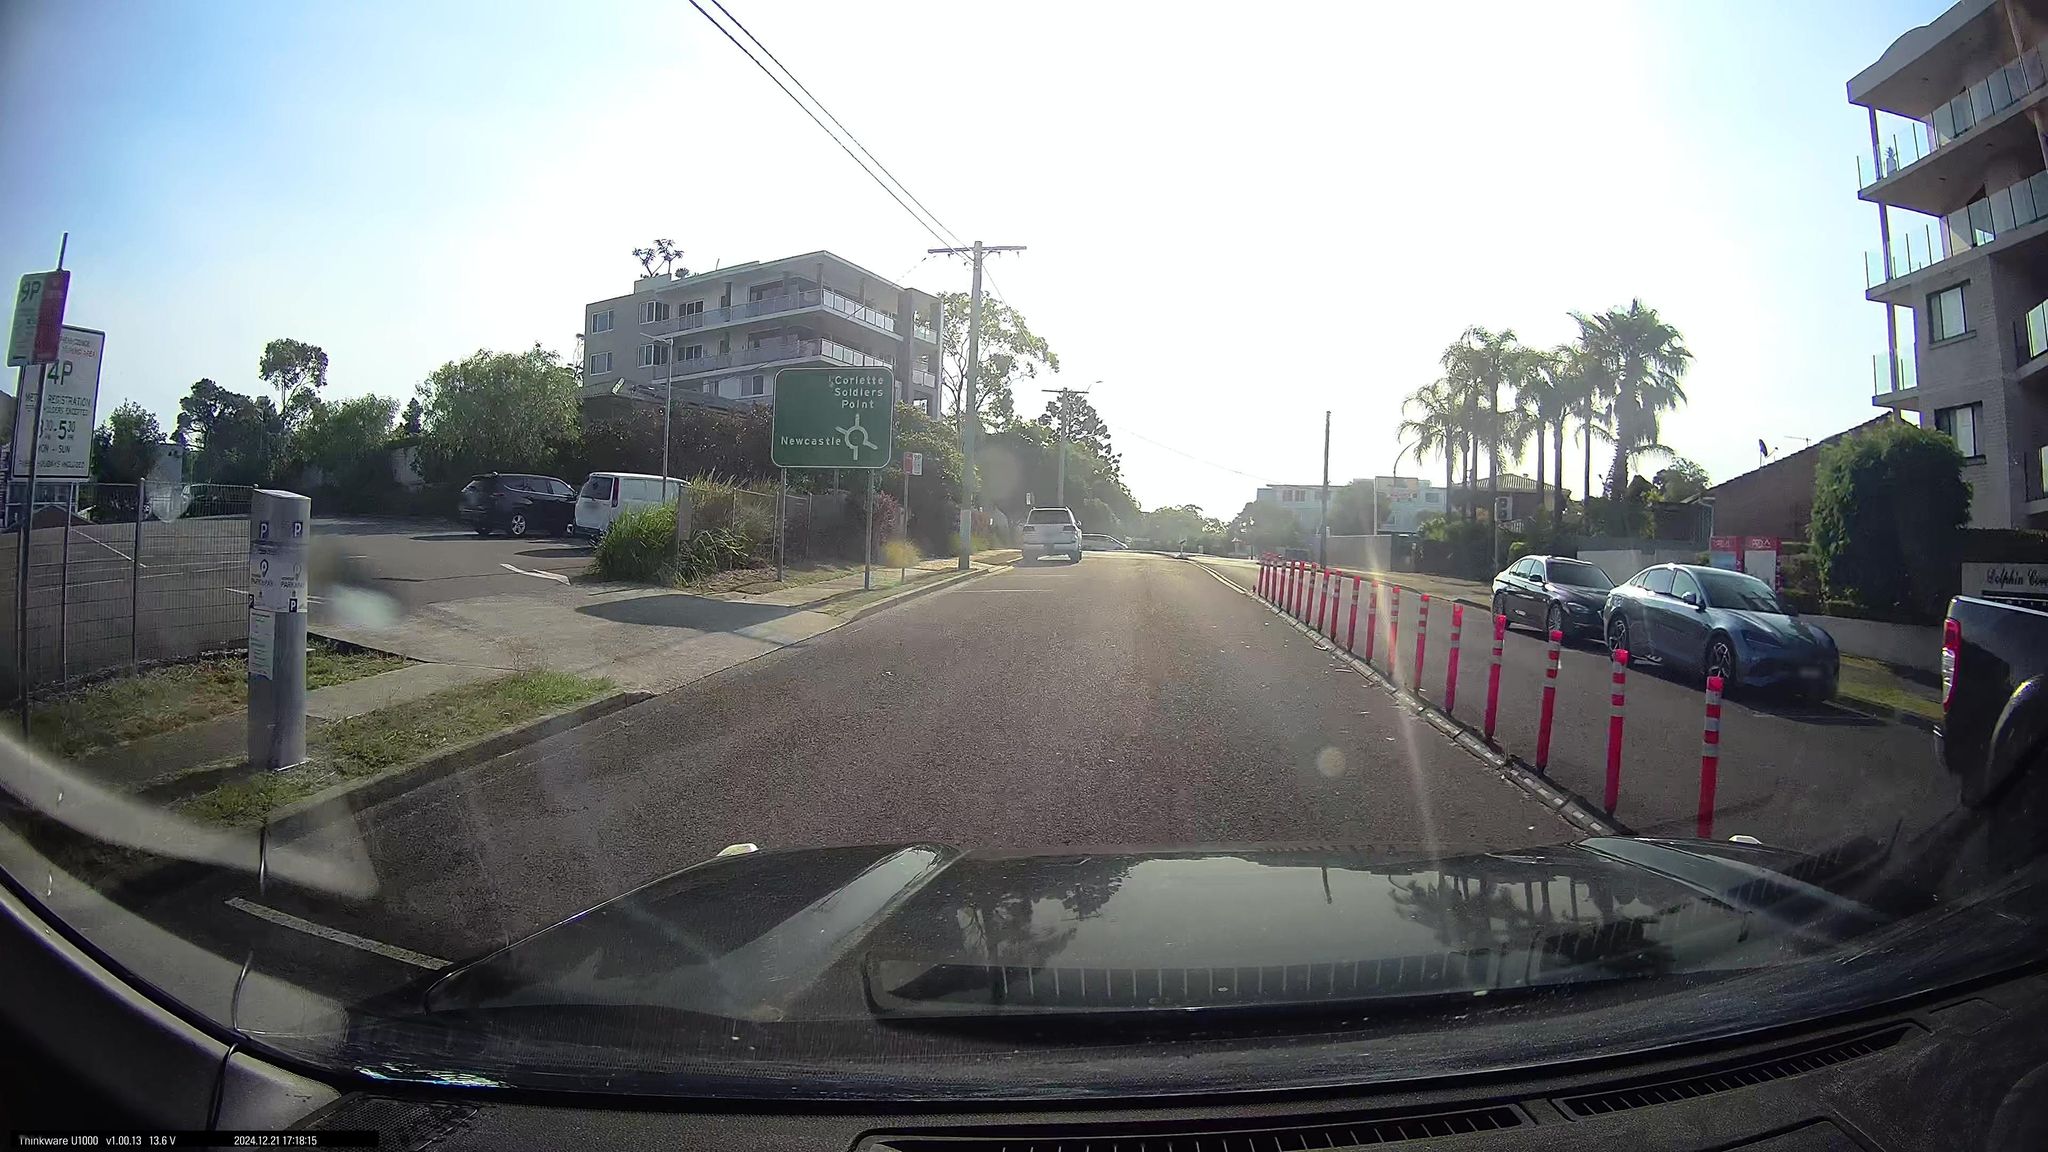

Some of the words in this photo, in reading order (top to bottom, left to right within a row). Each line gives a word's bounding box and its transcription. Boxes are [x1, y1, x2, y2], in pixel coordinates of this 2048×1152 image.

[47, 360, 73, 385] 4P
[834, 375, 884, 385] Corlette
[834, 387, 884, 397] Soldiers
[48, 394, 91, 407] REGISTRATION
[841, 399, 875, 409] Point
[781, 436, 842, 446] Newcastle
[58, 445, 71, 454] SUN
[1986, 567, 2024, 589] Dolphin
